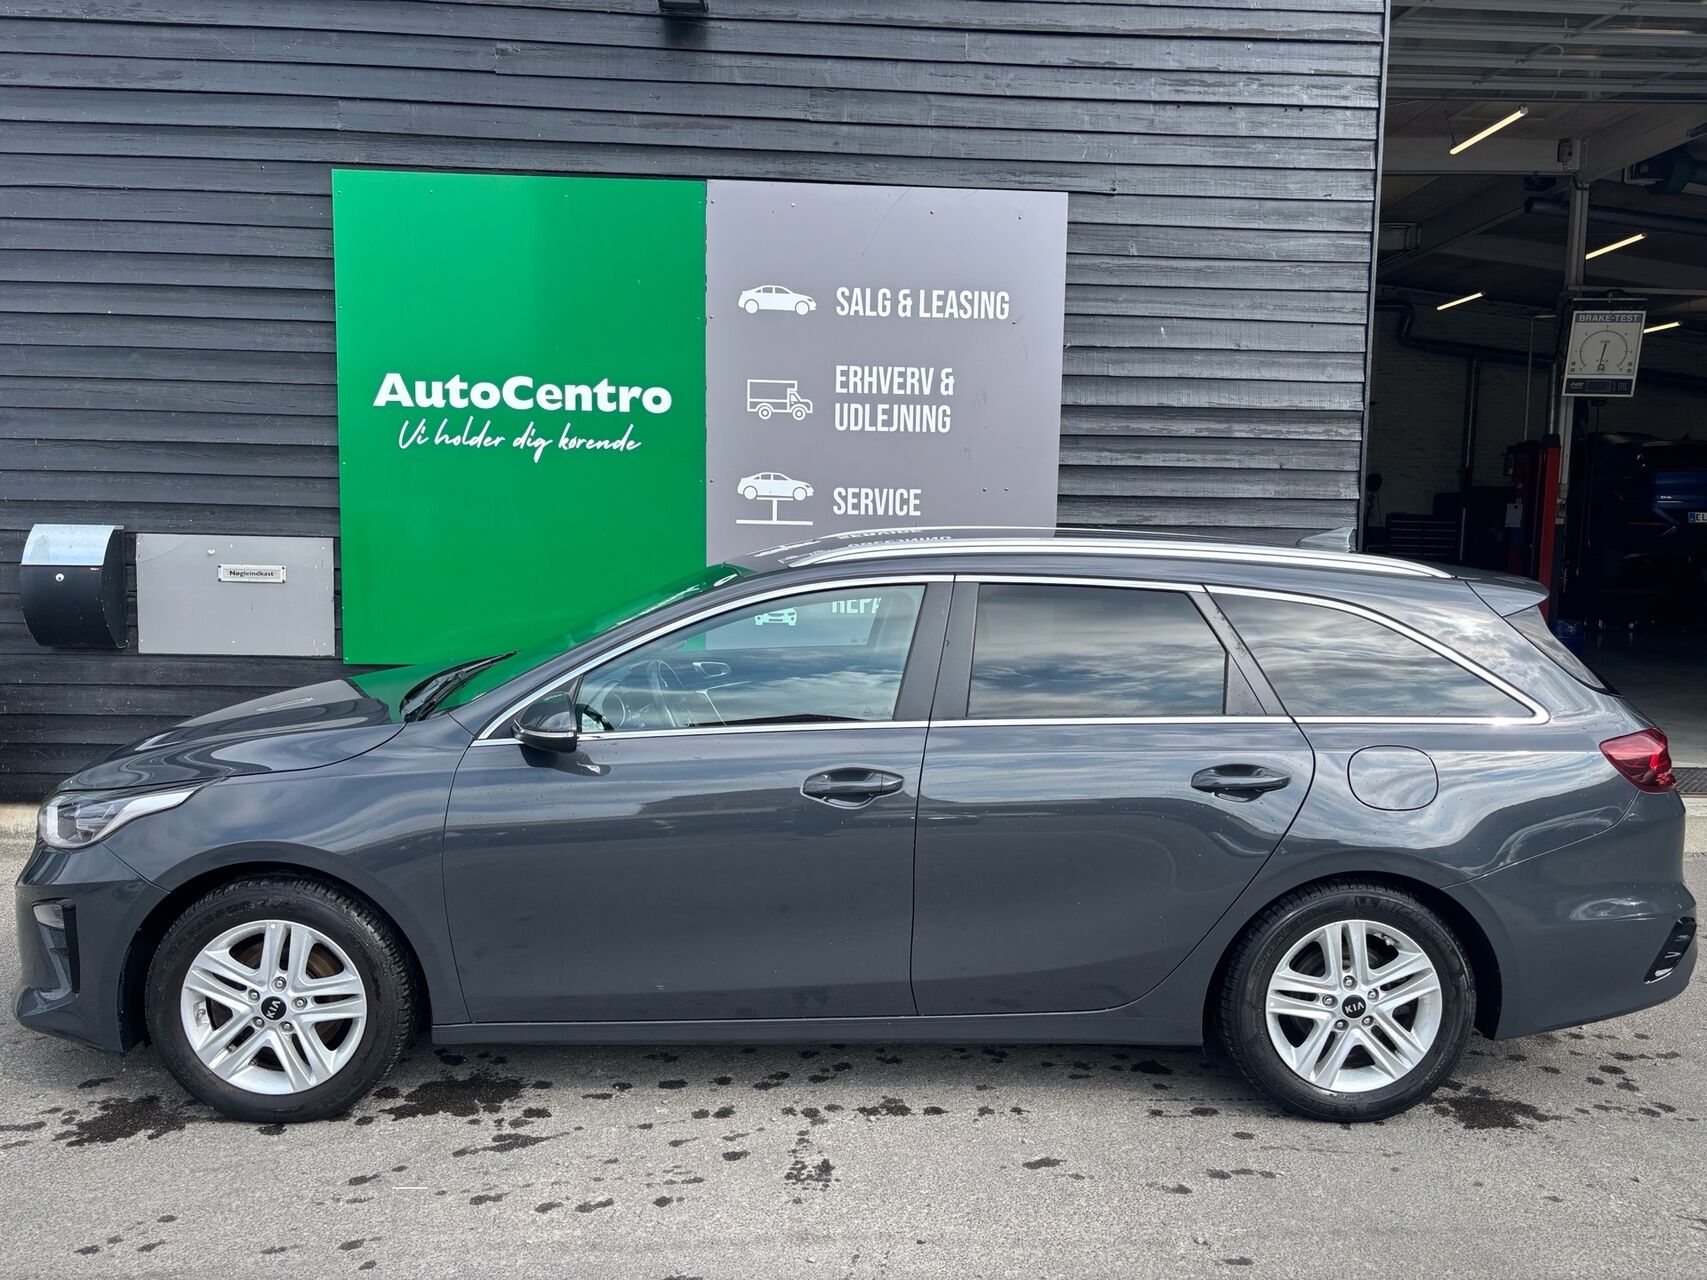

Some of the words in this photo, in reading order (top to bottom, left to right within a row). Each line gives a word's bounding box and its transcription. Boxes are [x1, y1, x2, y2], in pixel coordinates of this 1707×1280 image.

[836, 286, 892, 317] SALG
[897, 288, 913, 318] &
[919, 290, 1010, 320] LEASING
[373, 373, 673, 414] AutoCentro
[835, 365, 935, 395] ERHVERV
[940, 367, 955, 396] &
[834, 403, 952, 433] UDLEJNING
[398, 418, 429, 449] Vi
[434, 416, 506, 448] holder
[512, 421, 553, 463] dig
[558, 422, 642, 452] kørende
[833, 487, 922, 516] SERVICE
[266, 1000, 281, 1019] KIA
[1345, 1001, 1365, 1014] KIA
